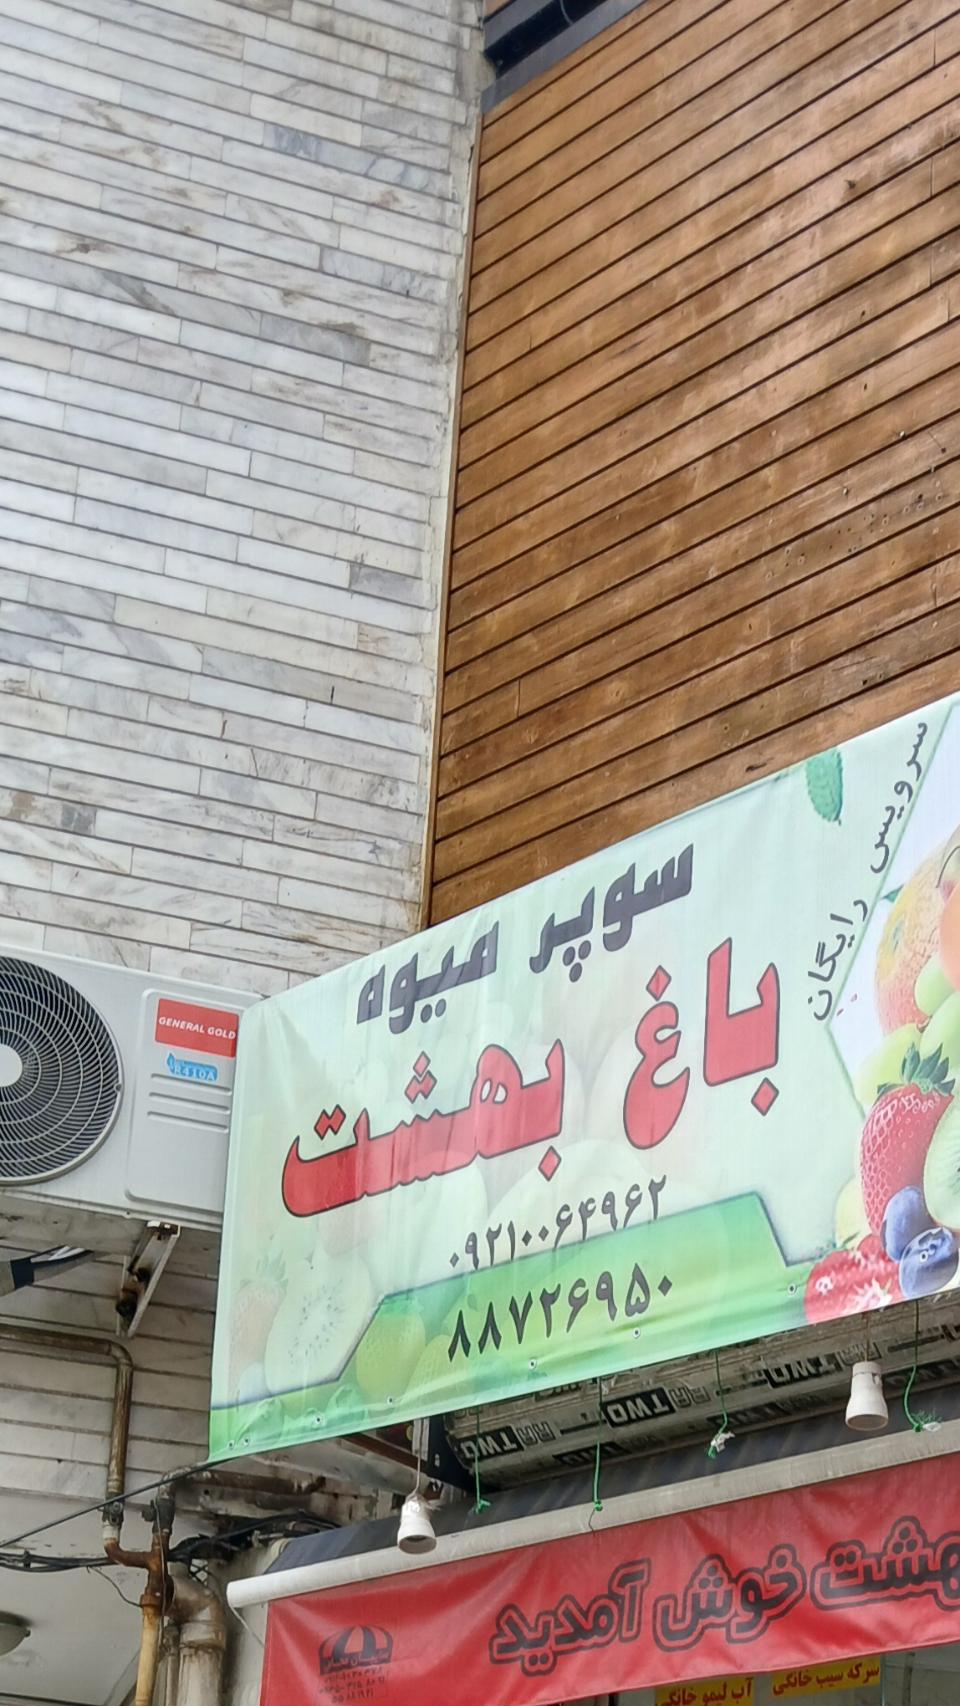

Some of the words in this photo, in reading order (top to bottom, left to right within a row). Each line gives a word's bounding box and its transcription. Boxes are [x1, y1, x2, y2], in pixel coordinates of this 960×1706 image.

[870, 722, 928, 874] سرویس
[529, 843, 694, 982] سوپر
[807, 899, 868, 1021] رایگان
[356, 920, 499, 1035] میوه
[158, 1016, 206, 1034] GENERAL
[207, 1025, 236, 1041] GOLD
[623, 937, 781, 1150] باغ
[282, 1039, 565, 1217] بهشت
[449, 1174, 668, 1272] ۰۹۲۱۰۰۶۴۹۶۲
[447, 1262, 673, 1363] ۸۸۷۲۶۹۵۰
[459, 1428, 518, 1459] TWO
[608, 1393, 670, 1424] TWO
[490, 1558, 651, 1675] آمدید
[653, 1544, 805, 1652] خوش
[729, 1677, 754, 1706] آب
[772, 1671, 812, 1695] خانگی
[814, 1670, 844, 1690] سیب
[848, 1662, 880, 1687] سرکه
